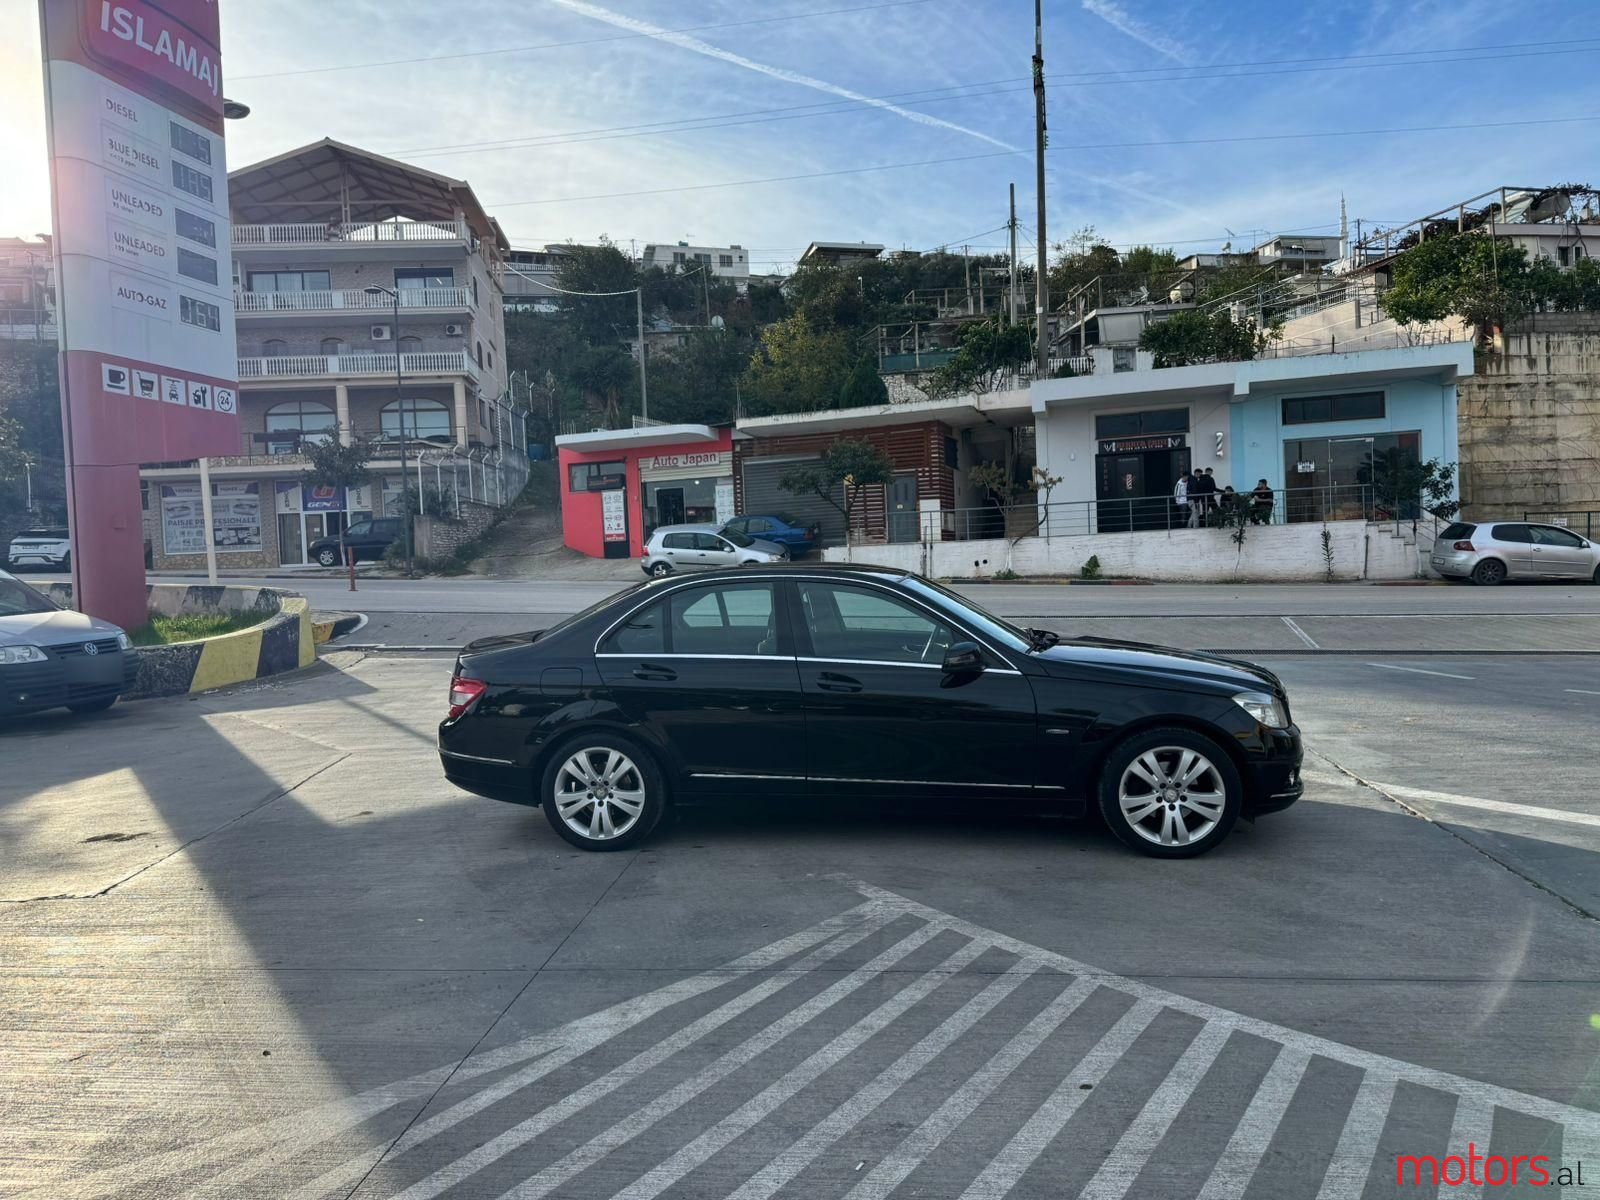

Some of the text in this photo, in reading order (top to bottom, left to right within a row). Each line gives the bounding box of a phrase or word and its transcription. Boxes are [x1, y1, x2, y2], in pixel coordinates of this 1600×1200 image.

[100, 0, 219, 97] ISLAMAJ
[106, 98, 138, 122] DIESEL
[108, 138, 131, 157] BLUE
[132, 148, 160, 169] DIESEL
[112, 189, 163, 217] UNLEADED
[114, 231, 165, 257] UNLEADED
[117, 286, 167, 310] AUTO-GAZ
[220, 395, 230, 405] 24
[652, 453, 717, 468] Auto Japan
[195, 517, 257, 526] PRFESIONALE
